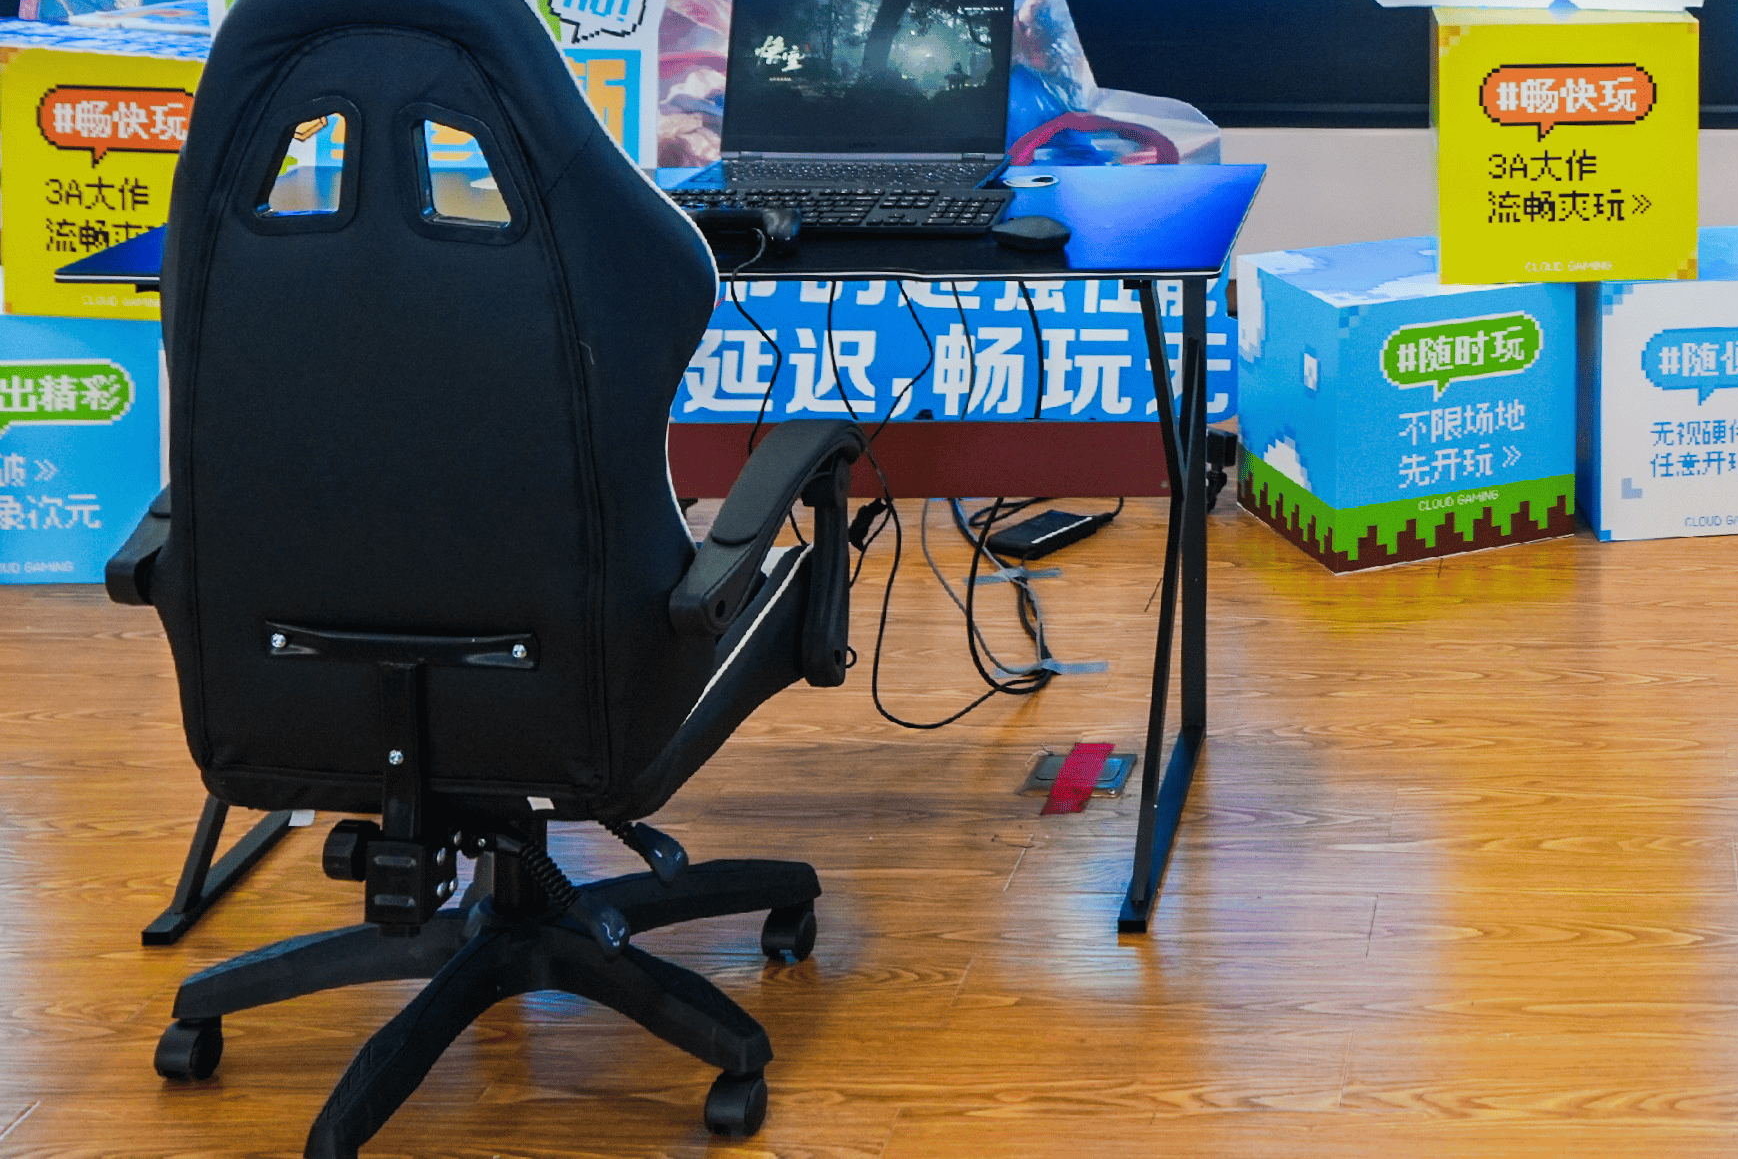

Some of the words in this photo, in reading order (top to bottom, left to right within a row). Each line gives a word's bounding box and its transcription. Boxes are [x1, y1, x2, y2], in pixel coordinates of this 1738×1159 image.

[1496, 77, 1636, 113] #畅快玩
[53, 100, 187, 140] #畅快玩
[1488, 149, 1597, 182] 3A大作
[45, 176, 149, 211] 3A大作
[1488, 188, 1625, 223] 流畅爽玩
[1524, 261, 1564, 273] CLOUD
[1397, 326, 1525, 373] #随时玩
[1399, 399, 1526, 445] 不限场地
[1399, 444, 1493, 488] 先开玩
[1418, 494, 1455, 512] CLOUD
[1457, 489, 1499, 505] GAMING
[1684, 516, 1722, 527] CLOUD
